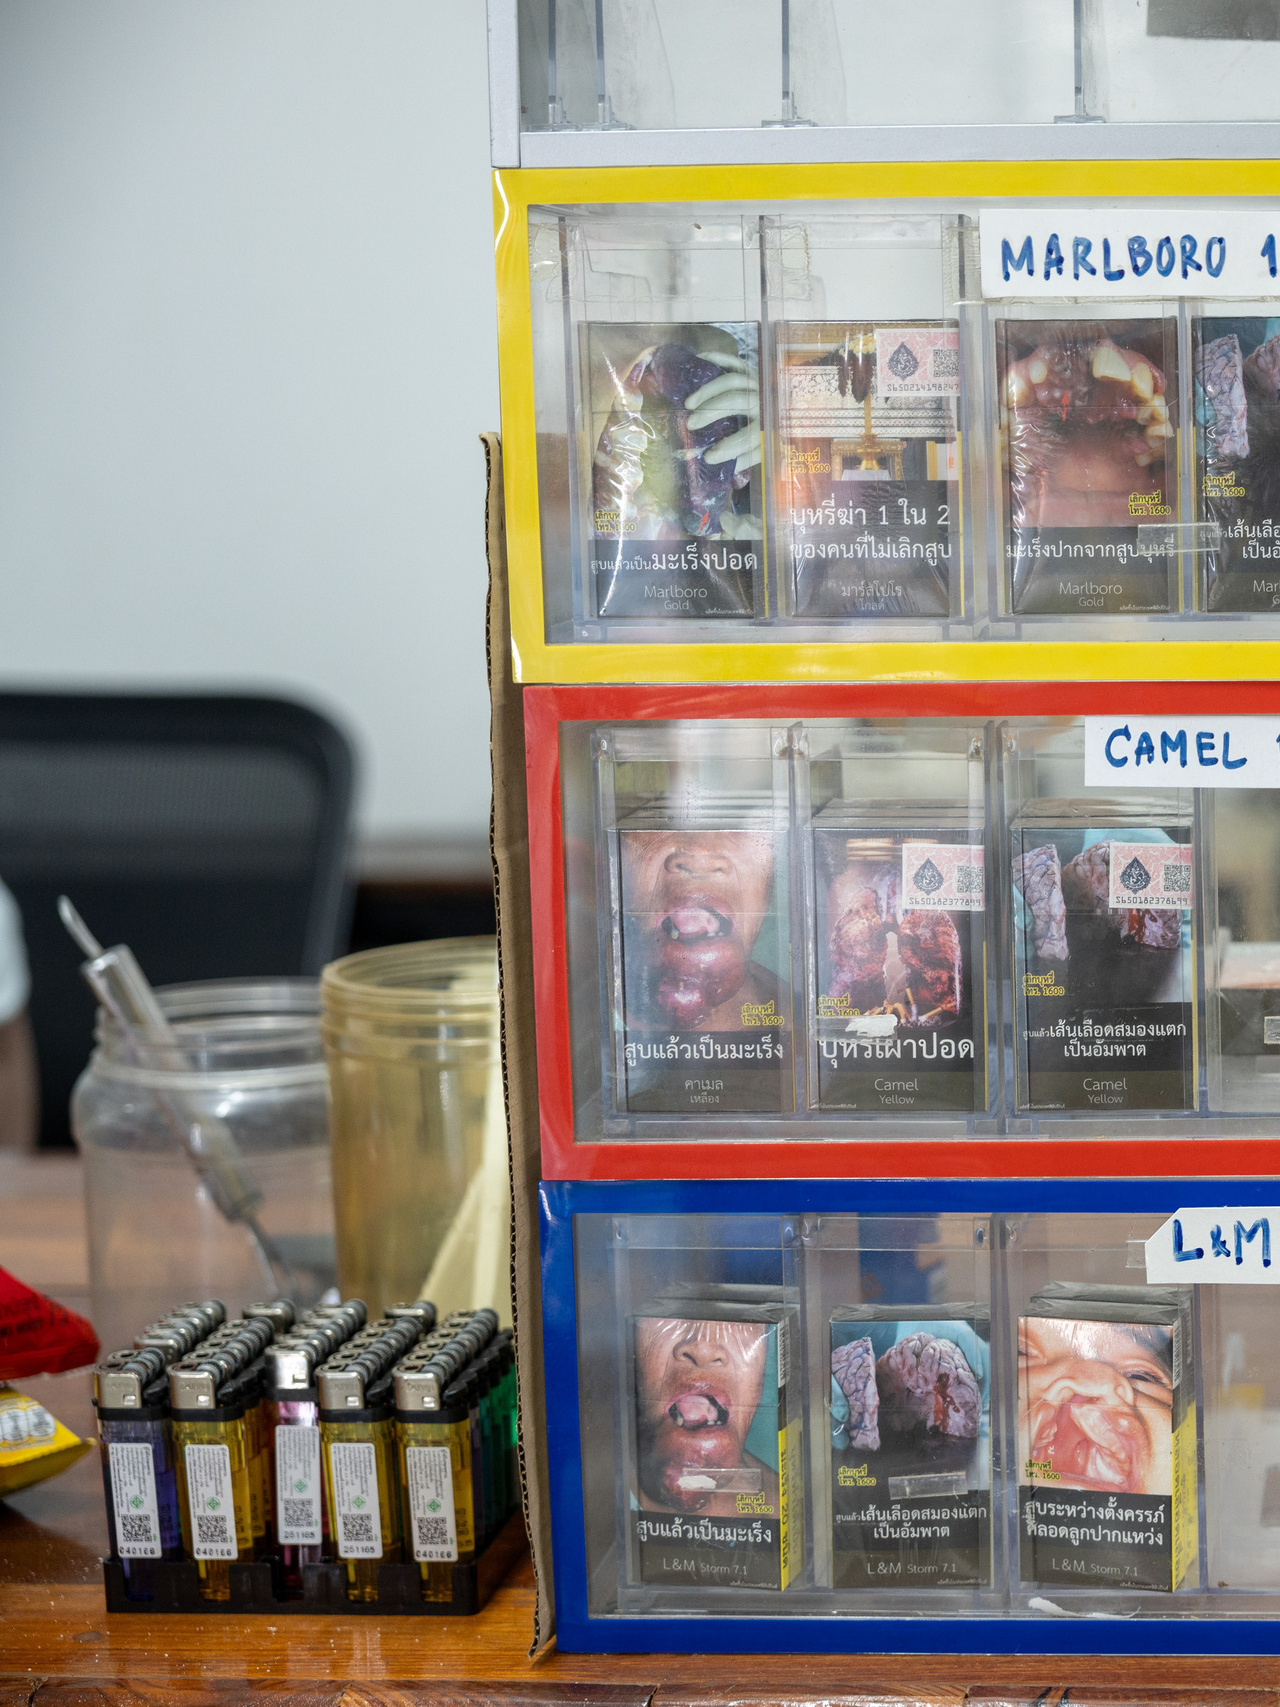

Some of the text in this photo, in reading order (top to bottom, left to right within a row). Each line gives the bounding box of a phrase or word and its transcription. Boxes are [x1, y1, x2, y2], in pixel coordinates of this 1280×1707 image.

[1001, 232, 1227, 281] MARLBORO
[808, 463, 831, 473] 1600
[1222, 487, 1246, 497] 1600
[1129, 490, 1161, 507] เลิกบุหรี่
[790, 493, 951, 534] บุหรี่ฆ่า 1 ใน 2
[1128, 503, 1171, 515] โทร. 1600
[614, 523, 636, 531] 100
[790, 531, 952, 567] ของคนที่ไม่เลิกสูบ
[643, 585, 708, 598] Marlboro
[1059, 582, 1123, 595] Marlboro
[664, 600, 690, 610] Gold
[1078, 597, 1104, 607] Gold
[1104, 724, 1248, 769] CAMEL
[1042, 986, 1065, 996] 1600
[762, 1015, 784, 1025] 1600
[625, 1034, 783, 1067] สูบแล้วเป็นมะเร็ง
[1064, 1038, 1147, 1057] เป็นอัมพาต
[685, 1079, 724, 1090] คาเมล
[874, 1079, 919, 1091] Camel
[1083, 1078, 1128, 1091] Camel
[690, 1092, 720, 1104] เหลือง
[879, 1095, 915, 1104] Yellow
[1088, 1094, 1124, 1104] Yellow
[1173, 1218, 1271, 1268] L&M
[856, 1477, 877, 1486] 1600
[1042, 1472, 1061, 1481] 1600
[754, 1505, 774, 1514] 1600
[636, 1517, 772, 1542] สูบแล้วเป็นมะเร็ง
[874, 1521, 950, 1539] เป็นอัมพาต
[663, 1558, 748, 1575] L&M Storm 7.1
[867, 1562, 957, 1575] L&M Storm 7.1
[1052, 1558, 1139, 1577] L&M Storm 7.1
